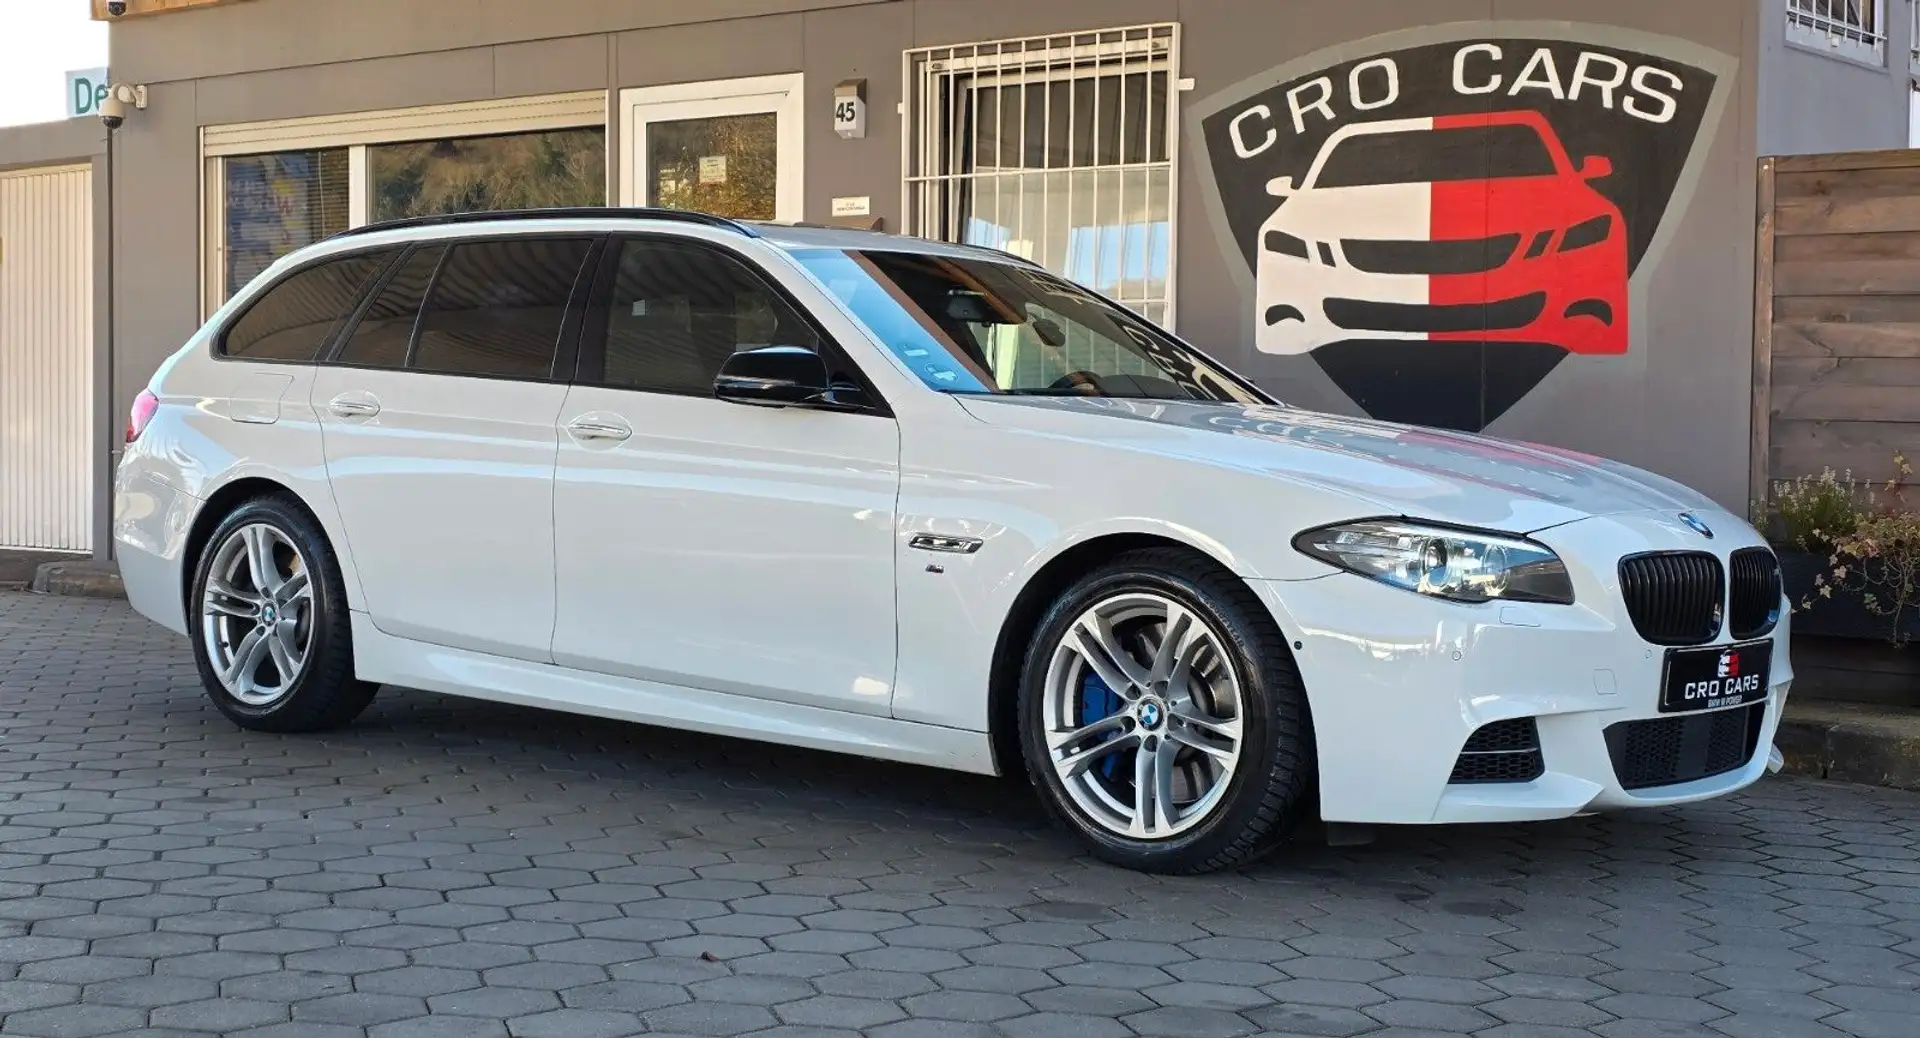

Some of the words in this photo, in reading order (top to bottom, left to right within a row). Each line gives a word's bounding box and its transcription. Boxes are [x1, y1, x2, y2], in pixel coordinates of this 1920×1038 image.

[836, 101, 856, 122] 45
[1228, 57, 1399, 159] CRO
[1452, 43, 1684, 124] CARS
[1684, 680, 1720, 700] CRO
[1725, 674, 1759, 695] CARS
